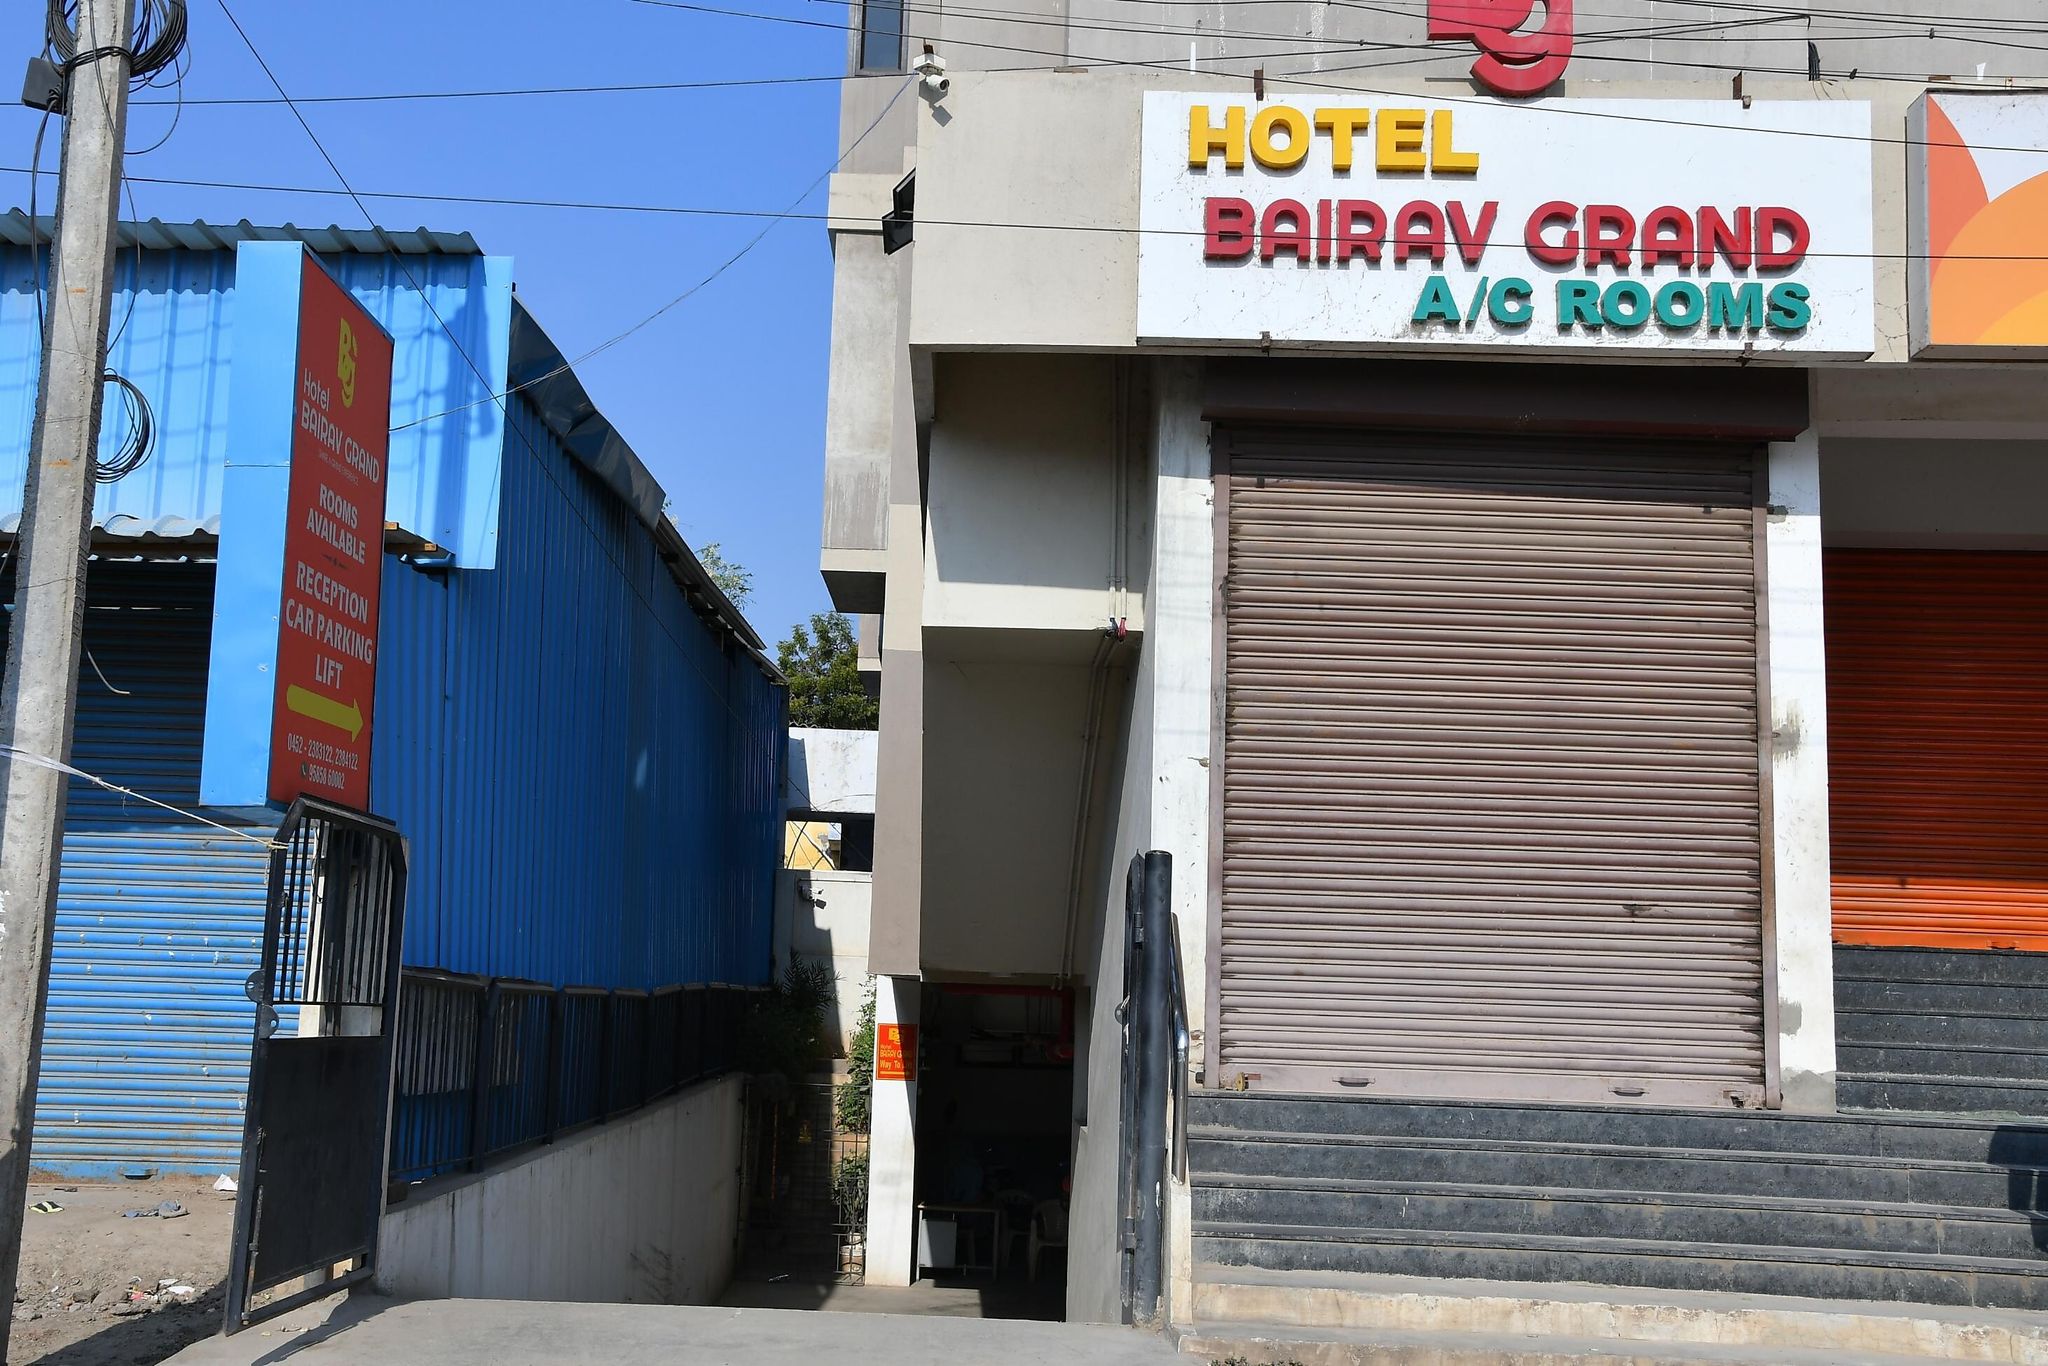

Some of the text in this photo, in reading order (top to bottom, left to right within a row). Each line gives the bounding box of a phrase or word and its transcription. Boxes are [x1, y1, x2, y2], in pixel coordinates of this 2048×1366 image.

[1188, 104, 1480, 175] HOTEL
[1203, 196, 1812, 271] BAIRAV GRAND
[1411, 275, 1812, 332] A/C ROOMS
[303, 367, 330, 412] Hotel
[301, 400, 343, 455] BAIRAV
[344, 437, 380, 483] GRAND
[319, 484, 358, 529] ROOMS
[306, 507, 366, 565] AVAILABLE
[296, 560, 369, 624] RECEPTION
[285, 599, 373, 665] CAR PARKING
[315, 654, 344, 689] LIFT
[287, 732, 304, 754] 0452
[880, 1059, 892, 1070] Way
